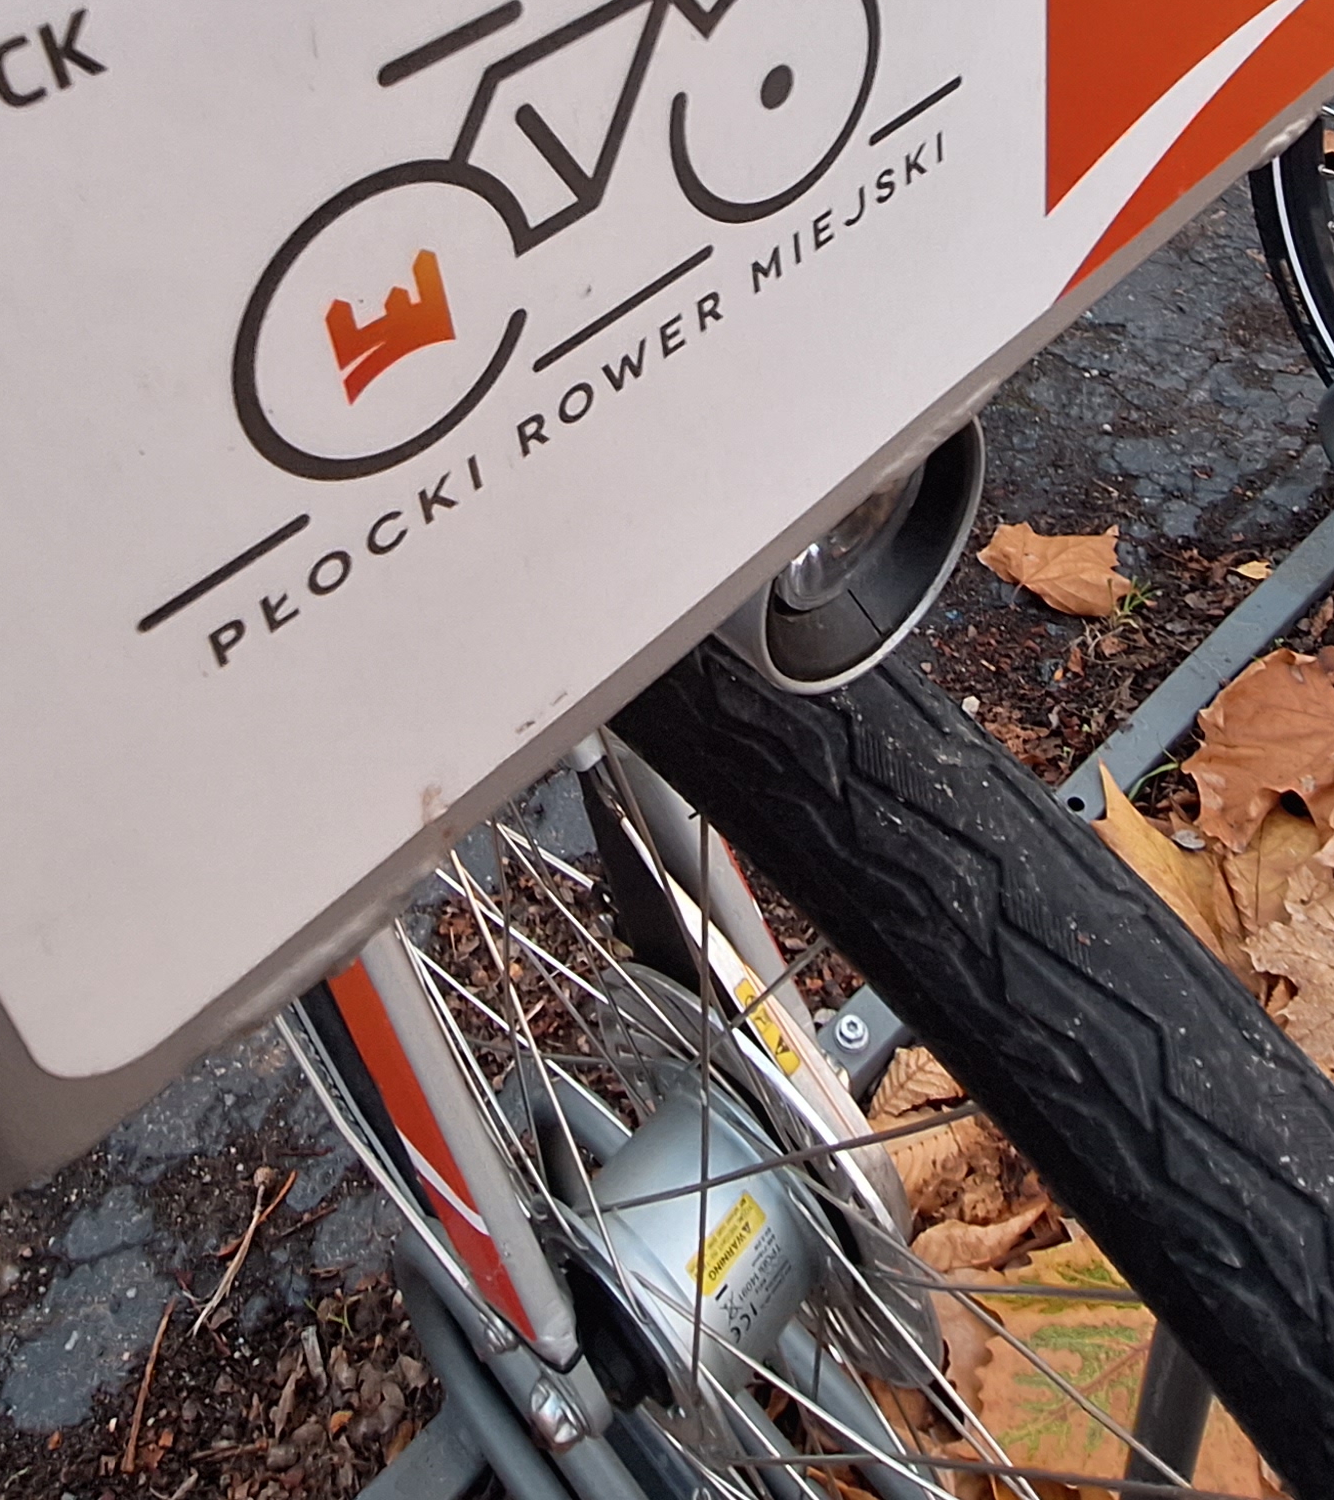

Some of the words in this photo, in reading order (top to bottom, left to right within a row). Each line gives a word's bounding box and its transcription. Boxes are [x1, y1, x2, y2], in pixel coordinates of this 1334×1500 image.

[208, 454, 486, 668] PŁOCKI
[516, 290, 724, 458] ROWER
[751, 130, 947, 294] MIEJSKI
[708, 1233, 748, 1281] WARNING
